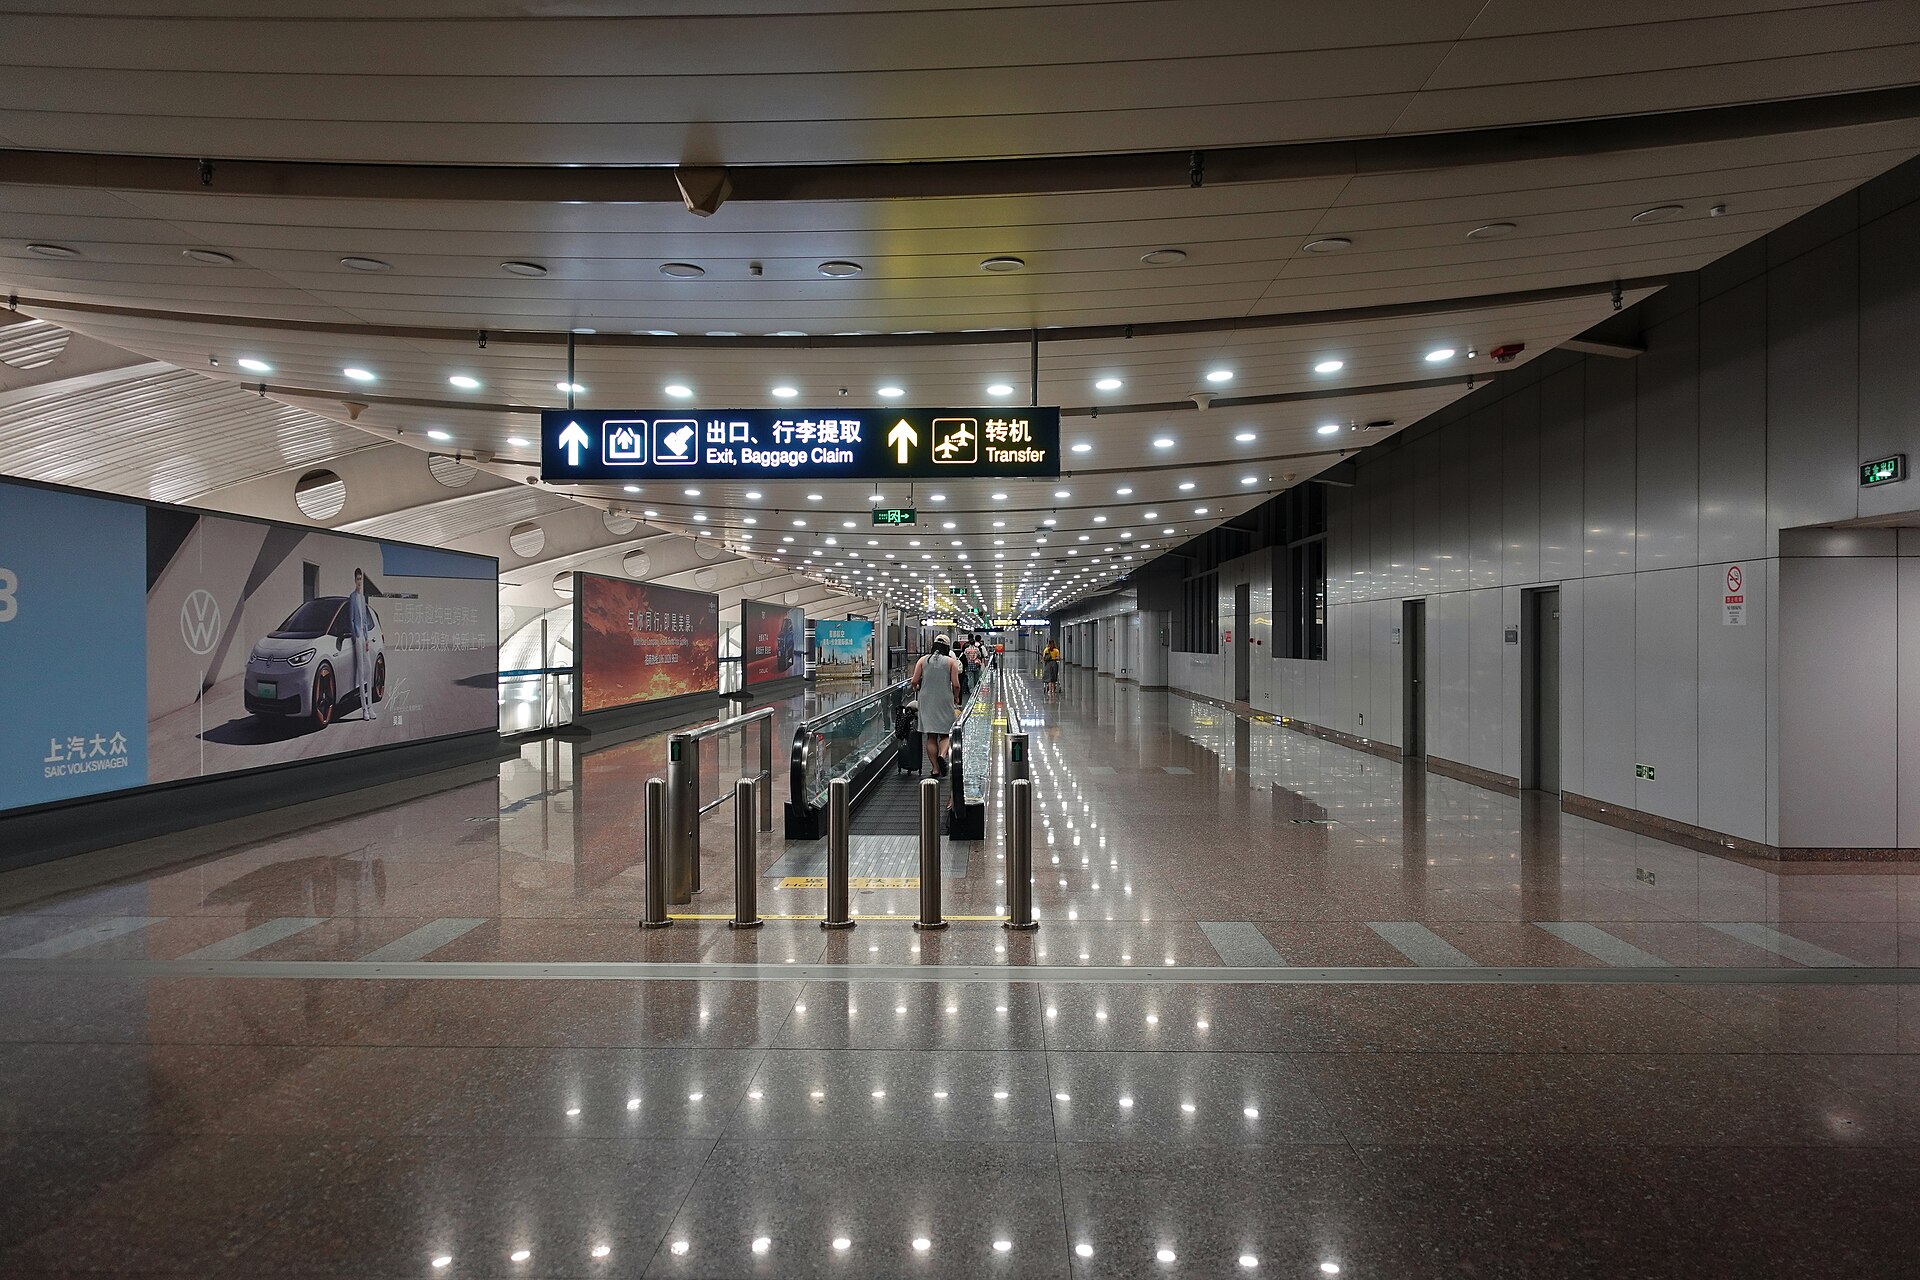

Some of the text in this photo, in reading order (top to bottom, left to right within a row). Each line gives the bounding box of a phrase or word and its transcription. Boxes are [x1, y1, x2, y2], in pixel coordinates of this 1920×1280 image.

[985, 419, 1032, 443] 转机
[706, 447, 853, 467] Exit, Baggage Claim
[985, 447, 1046, 463] Transfer
[44, 731, 128, 763] 上汽大众
[44, 757, 129, 778] SAIC VOLKSWAGEN
